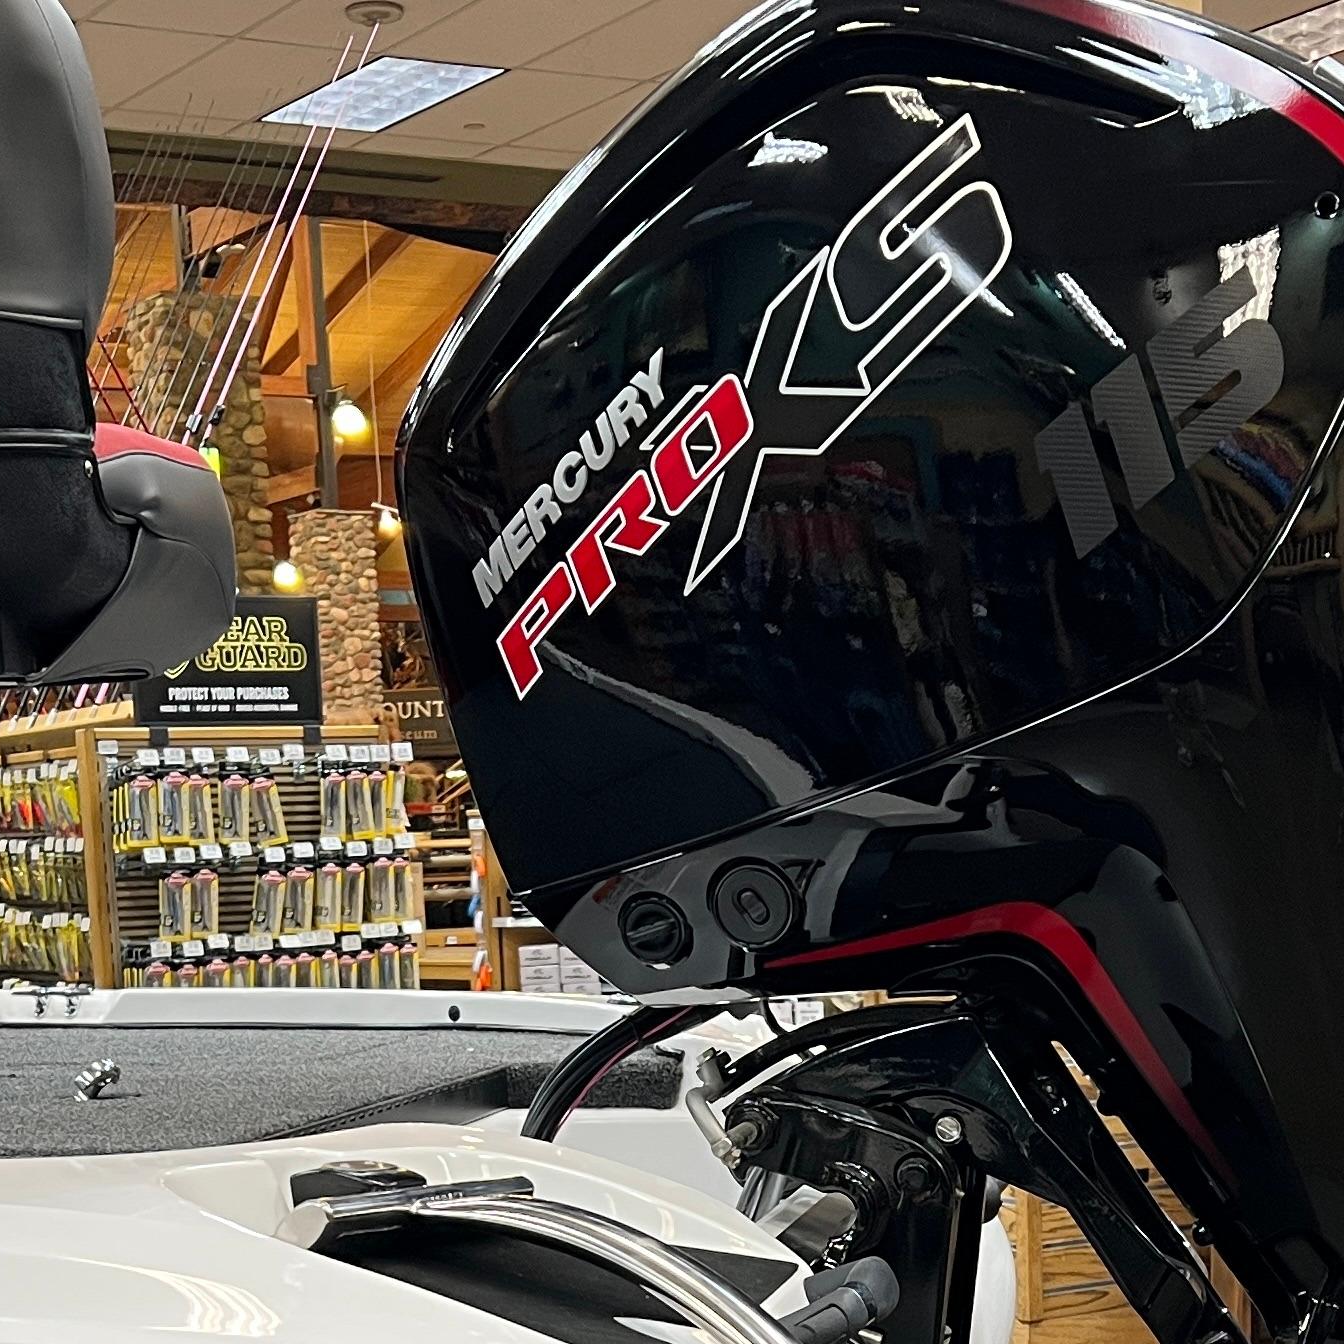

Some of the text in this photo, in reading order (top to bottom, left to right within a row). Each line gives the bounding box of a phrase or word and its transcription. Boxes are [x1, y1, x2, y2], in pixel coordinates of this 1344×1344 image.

[496, 112, 1013, 701] PRO XS
[1034, 264, 1287, 561] 115
[471, 346, 665, 608] MERCURY
[221, 616, 291, 644] EAR
[195, 643, 308, 672] GUARD
[168, 687, 290, 701] PROTECT YOUR PURCHASES
[382, 700, 445, 719] OUNT
